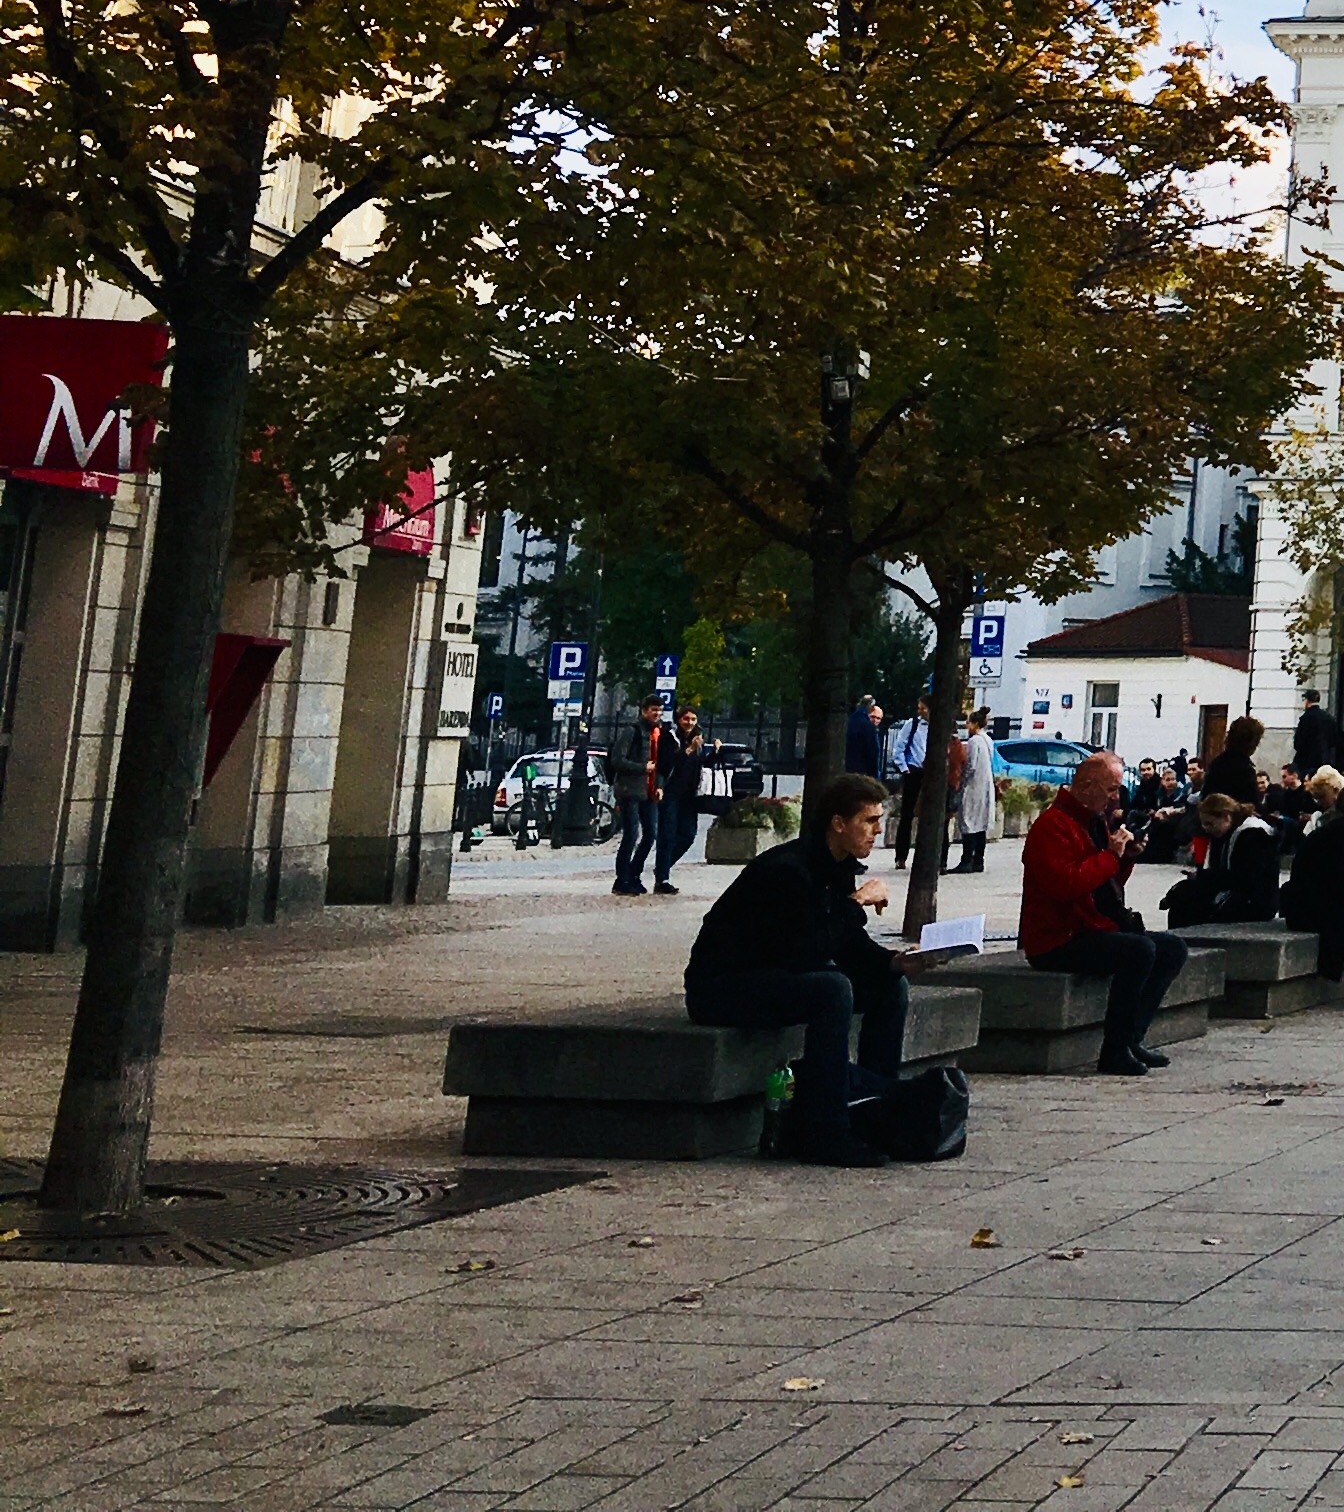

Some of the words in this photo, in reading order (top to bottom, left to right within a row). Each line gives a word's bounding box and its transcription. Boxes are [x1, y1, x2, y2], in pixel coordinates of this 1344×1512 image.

[979, 619, 999, 645] P
[446, 651, 475, 678] HOTEL
[558, 647, 583, 676] P
[491, 695, 503, 715] P
